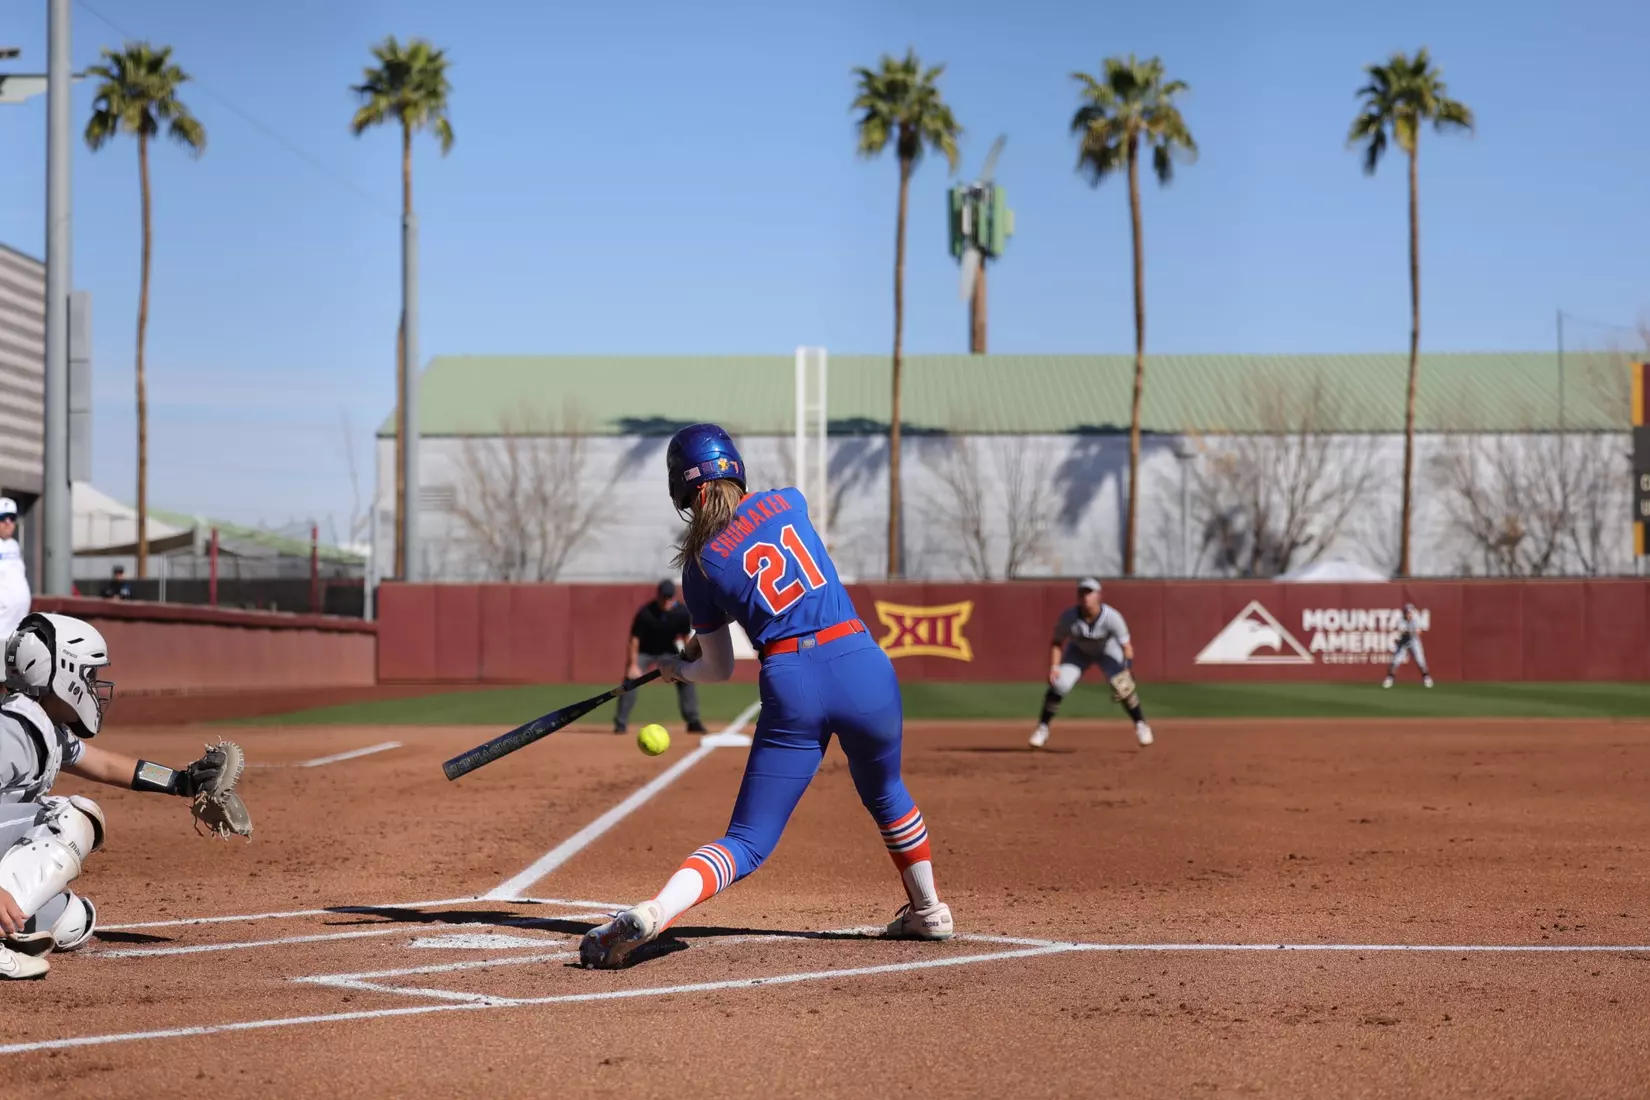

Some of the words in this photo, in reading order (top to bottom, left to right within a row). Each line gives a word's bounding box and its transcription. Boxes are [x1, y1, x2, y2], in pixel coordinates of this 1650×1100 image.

[710, 494, 792, 558] SHUMAKER
[743, 523, 828, 616] 21
[1302, 608, 1431, 631] MOUNTAN
[1310, 631, 1403, 653] AMERIC
